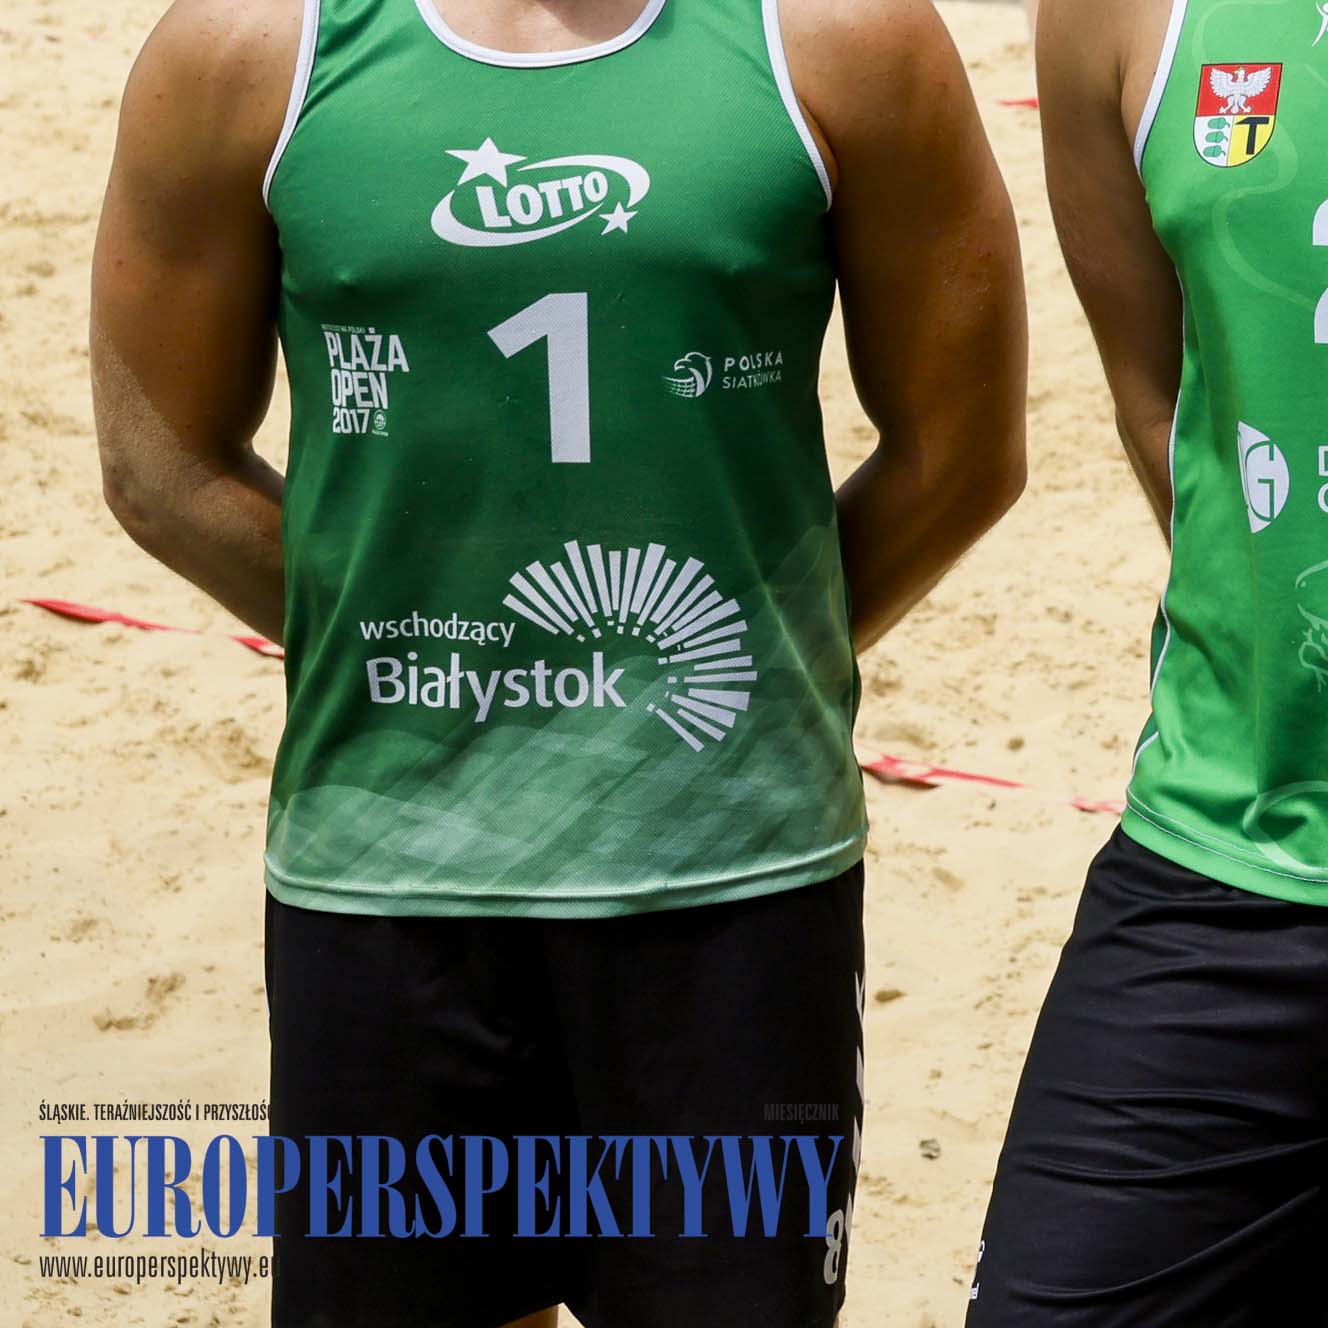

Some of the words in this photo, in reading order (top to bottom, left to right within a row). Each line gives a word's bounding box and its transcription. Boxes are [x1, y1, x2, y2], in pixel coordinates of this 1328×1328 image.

[475, 171, 609, 229] LOTTO
[324, 327, 410, 372] PLAŻA
[723, 350, 784, 372] POLSKA
[331, 368, 389, 410] OPEN
[487, 292, 592, 464] 1
[332, 406, 371, 434] 2017
[359, 610, 516, 648] wschodzący
[365, 651, 627, 724] Białystok
